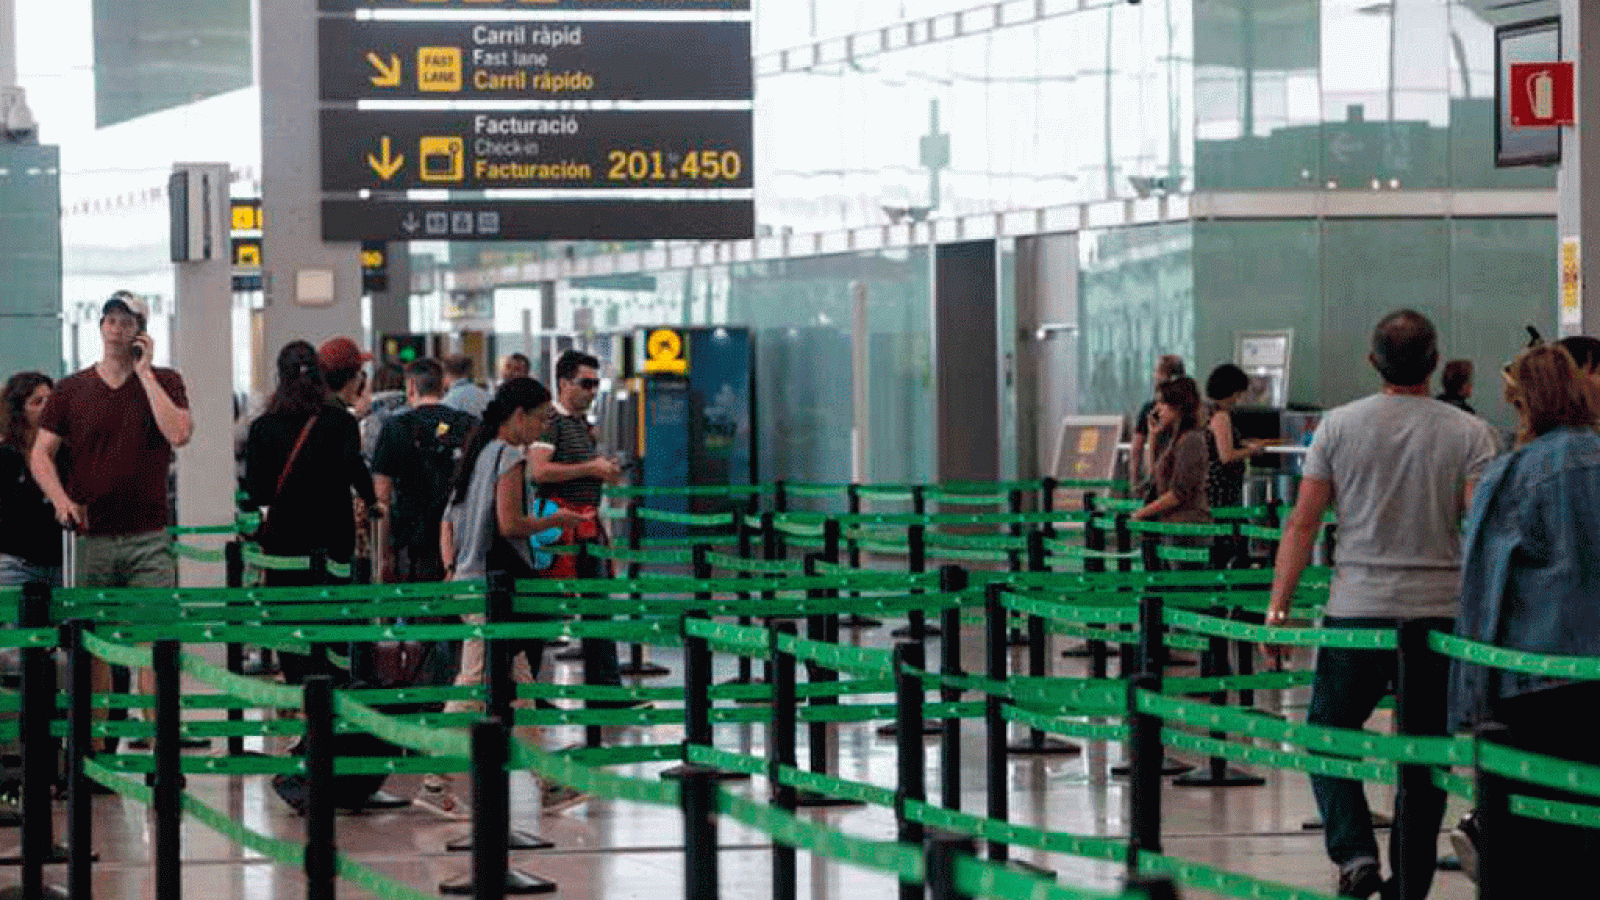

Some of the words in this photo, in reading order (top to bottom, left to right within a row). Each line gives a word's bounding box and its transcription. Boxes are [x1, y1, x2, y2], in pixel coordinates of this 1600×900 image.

[472, 25, 525, 45] Carril
[472, 49, 508, 66] Fast
[513, 49, 548, 66] lane
[473, 69, 526, 91] Carril
[532, 69, 595, 93] rápido
[474, 114, 579, 134] Facturació
[474, 159, 591, 179] Facturación
